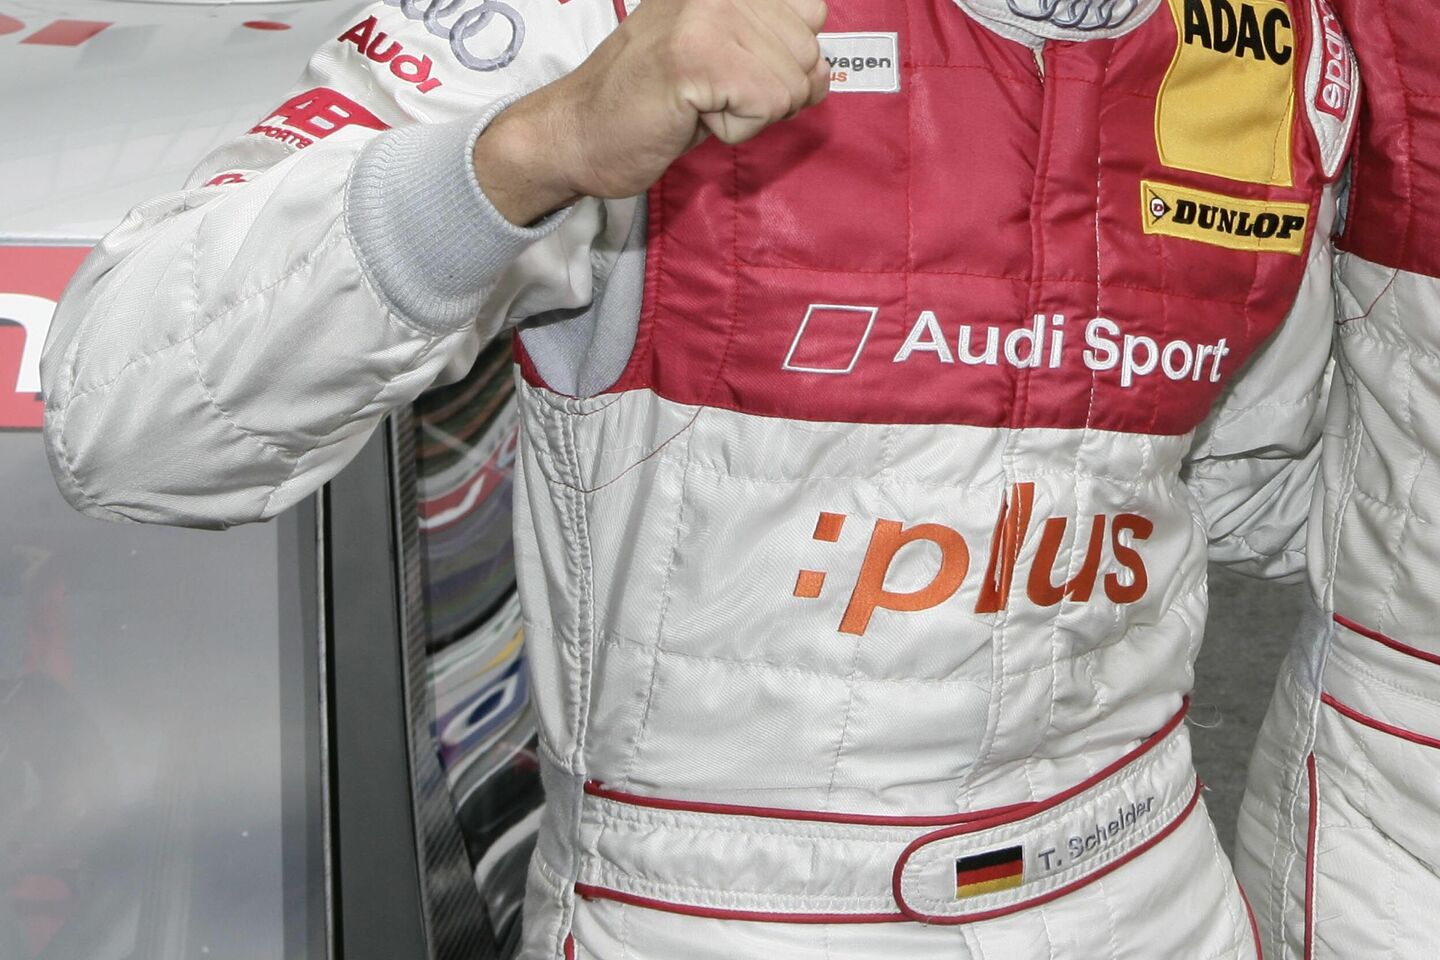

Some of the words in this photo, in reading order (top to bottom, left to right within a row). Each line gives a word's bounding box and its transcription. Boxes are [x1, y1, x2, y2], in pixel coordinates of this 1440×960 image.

[336, 14, 443, 94] Audi
[1171, 198, 1306, 240] DUNLOP
[892, 310, 1065, 370] Audi
[1082, 316, 1230, 387] Sport
[1037, 847, 1063, 871] T.
